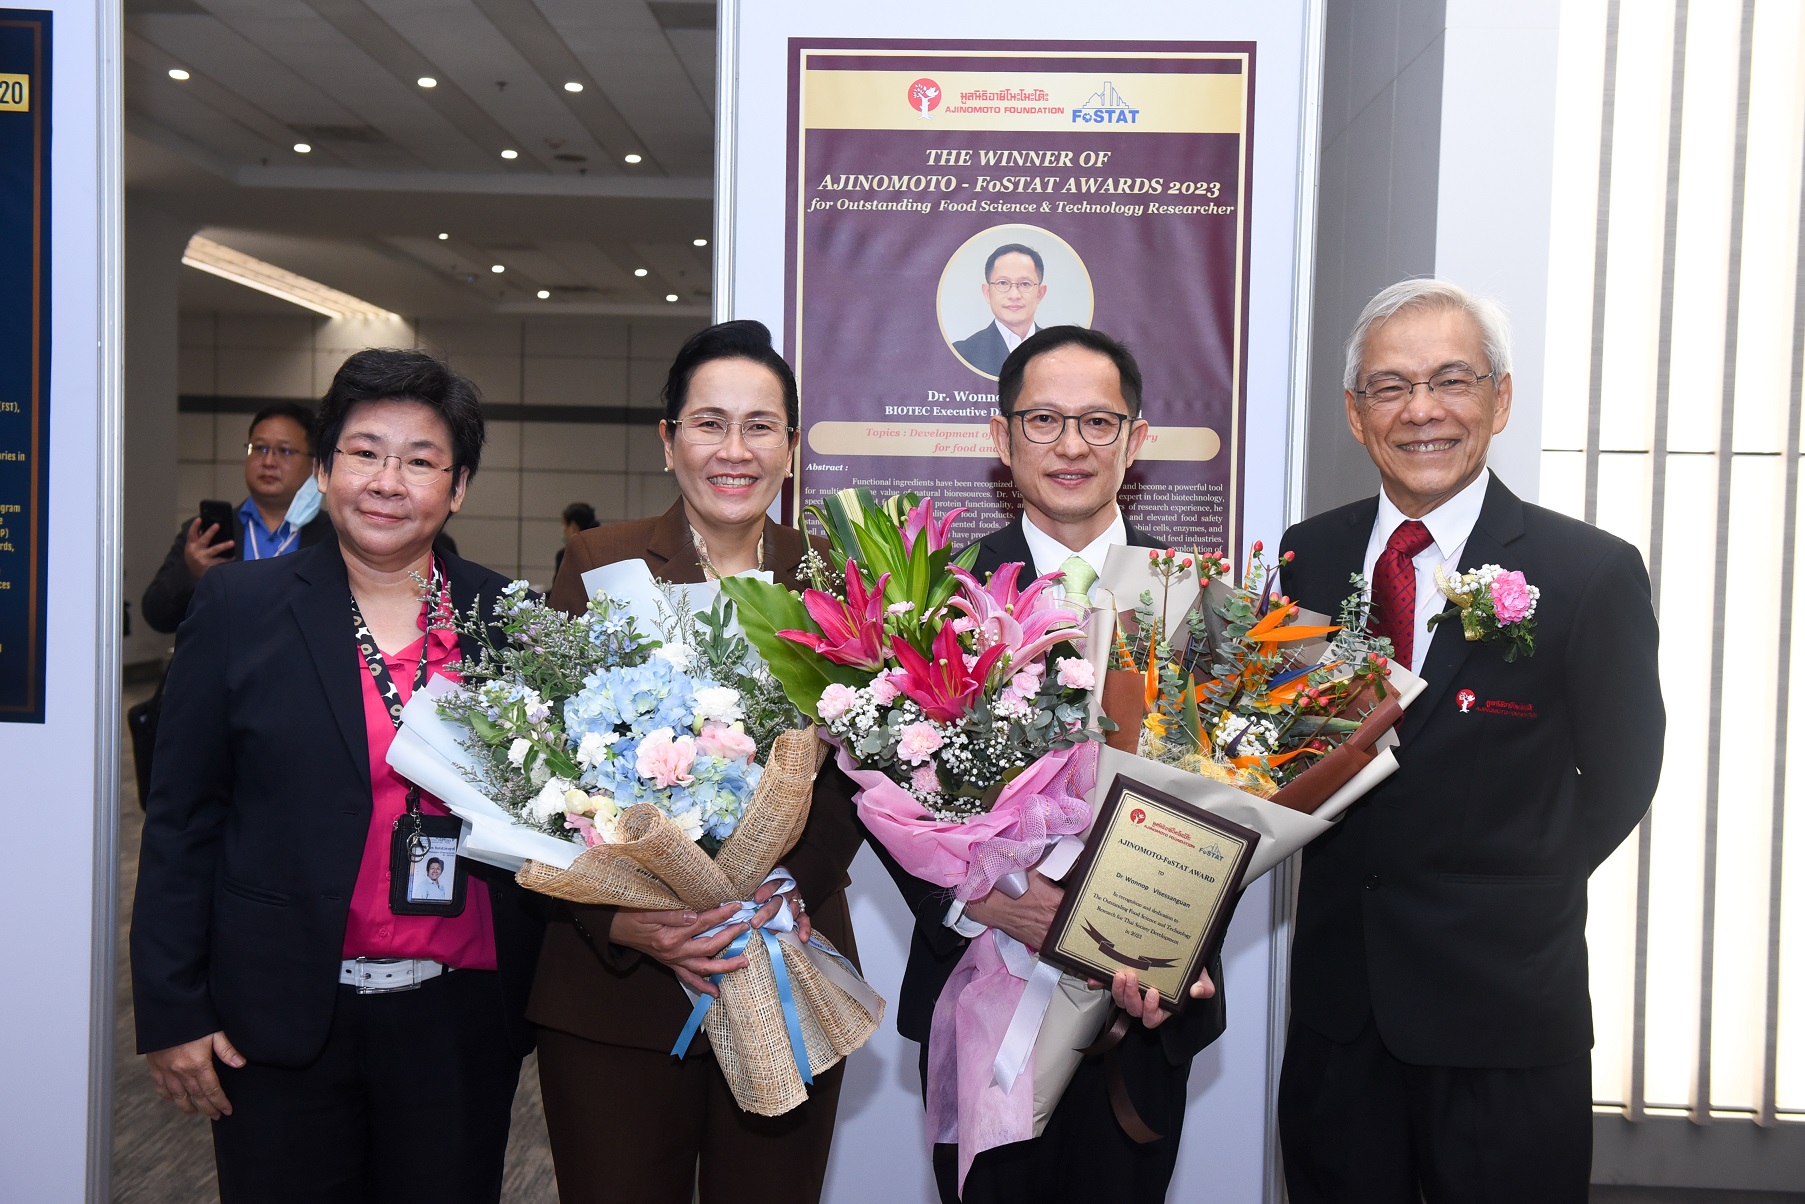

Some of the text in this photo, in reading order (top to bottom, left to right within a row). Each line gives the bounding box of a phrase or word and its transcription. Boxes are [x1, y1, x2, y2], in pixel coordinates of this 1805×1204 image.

[944, 106, 1064, 115] AJINOMOTO FOUNDATION
[926, 150, 1112, 167] THE WINNER OF
[817, 174, 957, 192] AJINOMOTO
[974, 176, 1060, 193] FoSTAT
[1061, 177, 1164, 194] AWARDS
[1167, 182, 1220, 198] 2023
[808, 198, 1234, 216] for Outstanding Food Science & Technology Researcher
[928, 390, 950, 402] Dr.
[885, 406, 930, 416] BIOTEC
[933, 406, 988, 416] Executive
[866, 428, 900, 438] Topics
[910, 428, 979, 440] Development
[932, 443, 950, 454] for
[952, 444, 976, 454] food
[806, 463, 843, 471] Abstract
[852, 478, 891, 486] Functional
[892, 478, 934, 487] ingredients
[936, 478, 952, 487] have
[974, 480, 1013, 489] recognized
[1122, 482, 1136, 490] and
[1174, 484, 1206, 492] powerful
[1208, 484, 1223, 492] tool
[804, 486, 816, 494] for
[880, 488, 900, 496] value
[944, 490, 992, 498] bioresources.
[996, 490, 1008, 498] Dr.
[1118, 494, 1142, 502] expert
[1144, 492, 1151, 500] in
[1152, 493, 1170, 501] food
[1171, 494, 1225, 503] biotechnology,
[935, 500, 961, 508] protein
[965, 500, 1014, 509] functionality,
[1138, 503, 1168, 511] research
[1170, 504, 1212, 512] experience,
[1214, 504, 1223, 512] he
[981, 511, 1015, 519] products,
[1129, 513, 1143, 521] and
[1201, 514, 1223, 523] safety
[979, 521, 1001, 529] foods.
[1153, 524, 1171, 532] cells,
[1185, 534, 1223, 543] industries.
[1118, 838, 1215, 883] AJINOMOTO-FoSTAT AWARD
[1125, 875, 1149, 891] Wonnop
[1153, 888, 1191, 908] Visessanguan
[1128, 908, 1140, 917] Food
[1124, 917, 1134, 926] Thai
